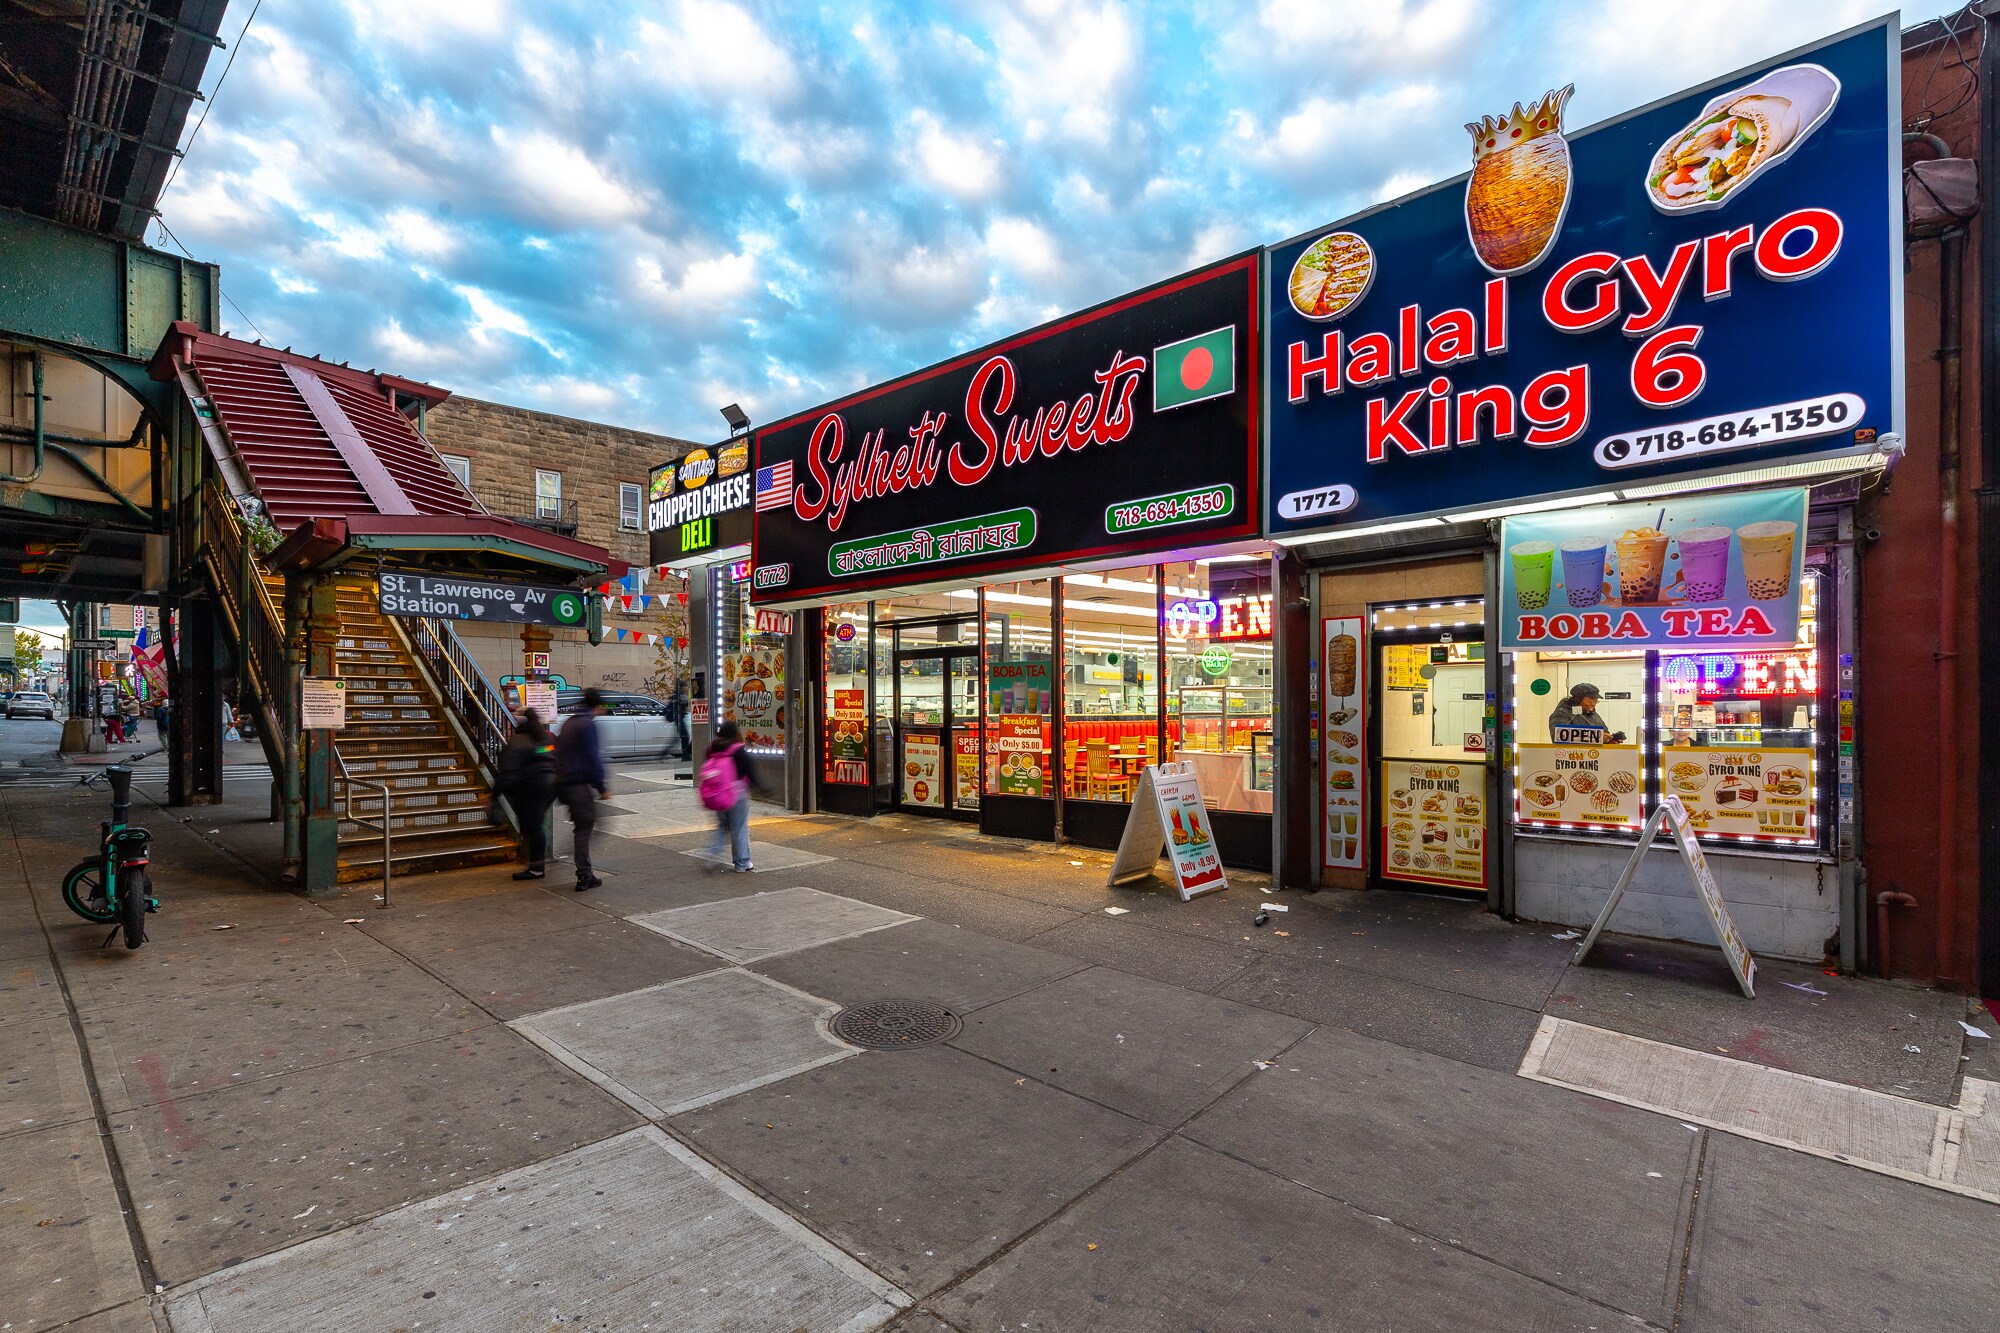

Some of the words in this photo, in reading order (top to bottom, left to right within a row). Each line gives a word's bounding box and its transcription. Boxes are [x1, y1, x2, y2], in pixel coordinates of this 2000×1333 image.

[1287, 276, 1509, 405] Halal
[1542, 207, 1845, 339] Gyro
[1366, 362, 1591, 464] King
[1630, 324, 1707, 410] 6
[1636, 400, 1848, 456] 718-684-1350
[794, 411, 947, 532] Sylheti
[947, 349, 1147, 487] Sweets
[678, 458, 716, 482] SANTIAGO
[648, 489, 701, 532] CHOPPED
[702, 472, 750, 517] CHEESE
[1114, 490, 1225, 528] 718-684-1350
[1293, 489, 1341, 513] 1772
[681, 517, 711, 552] DELI
[835, 529, 934, 573] বাংলাদেশী
[937, 519, 1020, 564] রান্নাঘর
[757, 566, 786, 586] 1772
[382, 575, 411, 593] St.
[420, 578, 516, 601] Lawrence
[524, 588, 546, 604] Av
[382, 594, 460, 615] Station
[560, 599, 574, 618] 6
[758, 612, 789, 633] ATM
[1169, 596, 1272, 639] OPEN
[1517, 612, 1651, 641] BOBA
[1661, 606, 1776, 638] TEA
[840, 628, 853, 637] ATM
[993, 665, 1023, 678] BOBA
[1025, 664, 1046, 677] TEA
[1665, 654, 1817, 696] OPEN
[737, 690, 772, 708] SANTIAGO
[835, 691, 850, 700] Lunch
[844, 699, 863, 707] Special
[835, 710, 848, 719] Only
[1001, 716, 1037, 726] Breakfast
[1014, 726, 1040, 736] Special
[1559, 728, 1600, 744] OPEN
[959, 737, 979, 746] SPEC
[964, 745, 979, 753] OFF
[1002, 739, 1020, 750] Only
[1021, 741, 1040, 750] $5.00
[837, 763, 863, 783] ATM
[1555, 759, 1577, 771] GYRO
[1579, 760, 1599, 771] KING
[1709, 763, 1735, 777] GYRO
[1738, 765, 1761, 778] KING
[1410, 777, 1434, 791] GYRO
[1437, 778, 1459, 794] KING
[1771, 798, 1802, 806] Burgers
[1760, 826, 1806, 835] Tea/Shakes
[1181, 861, 1196, 873] Only
[1198, 854, 1216, 867] $8.99
